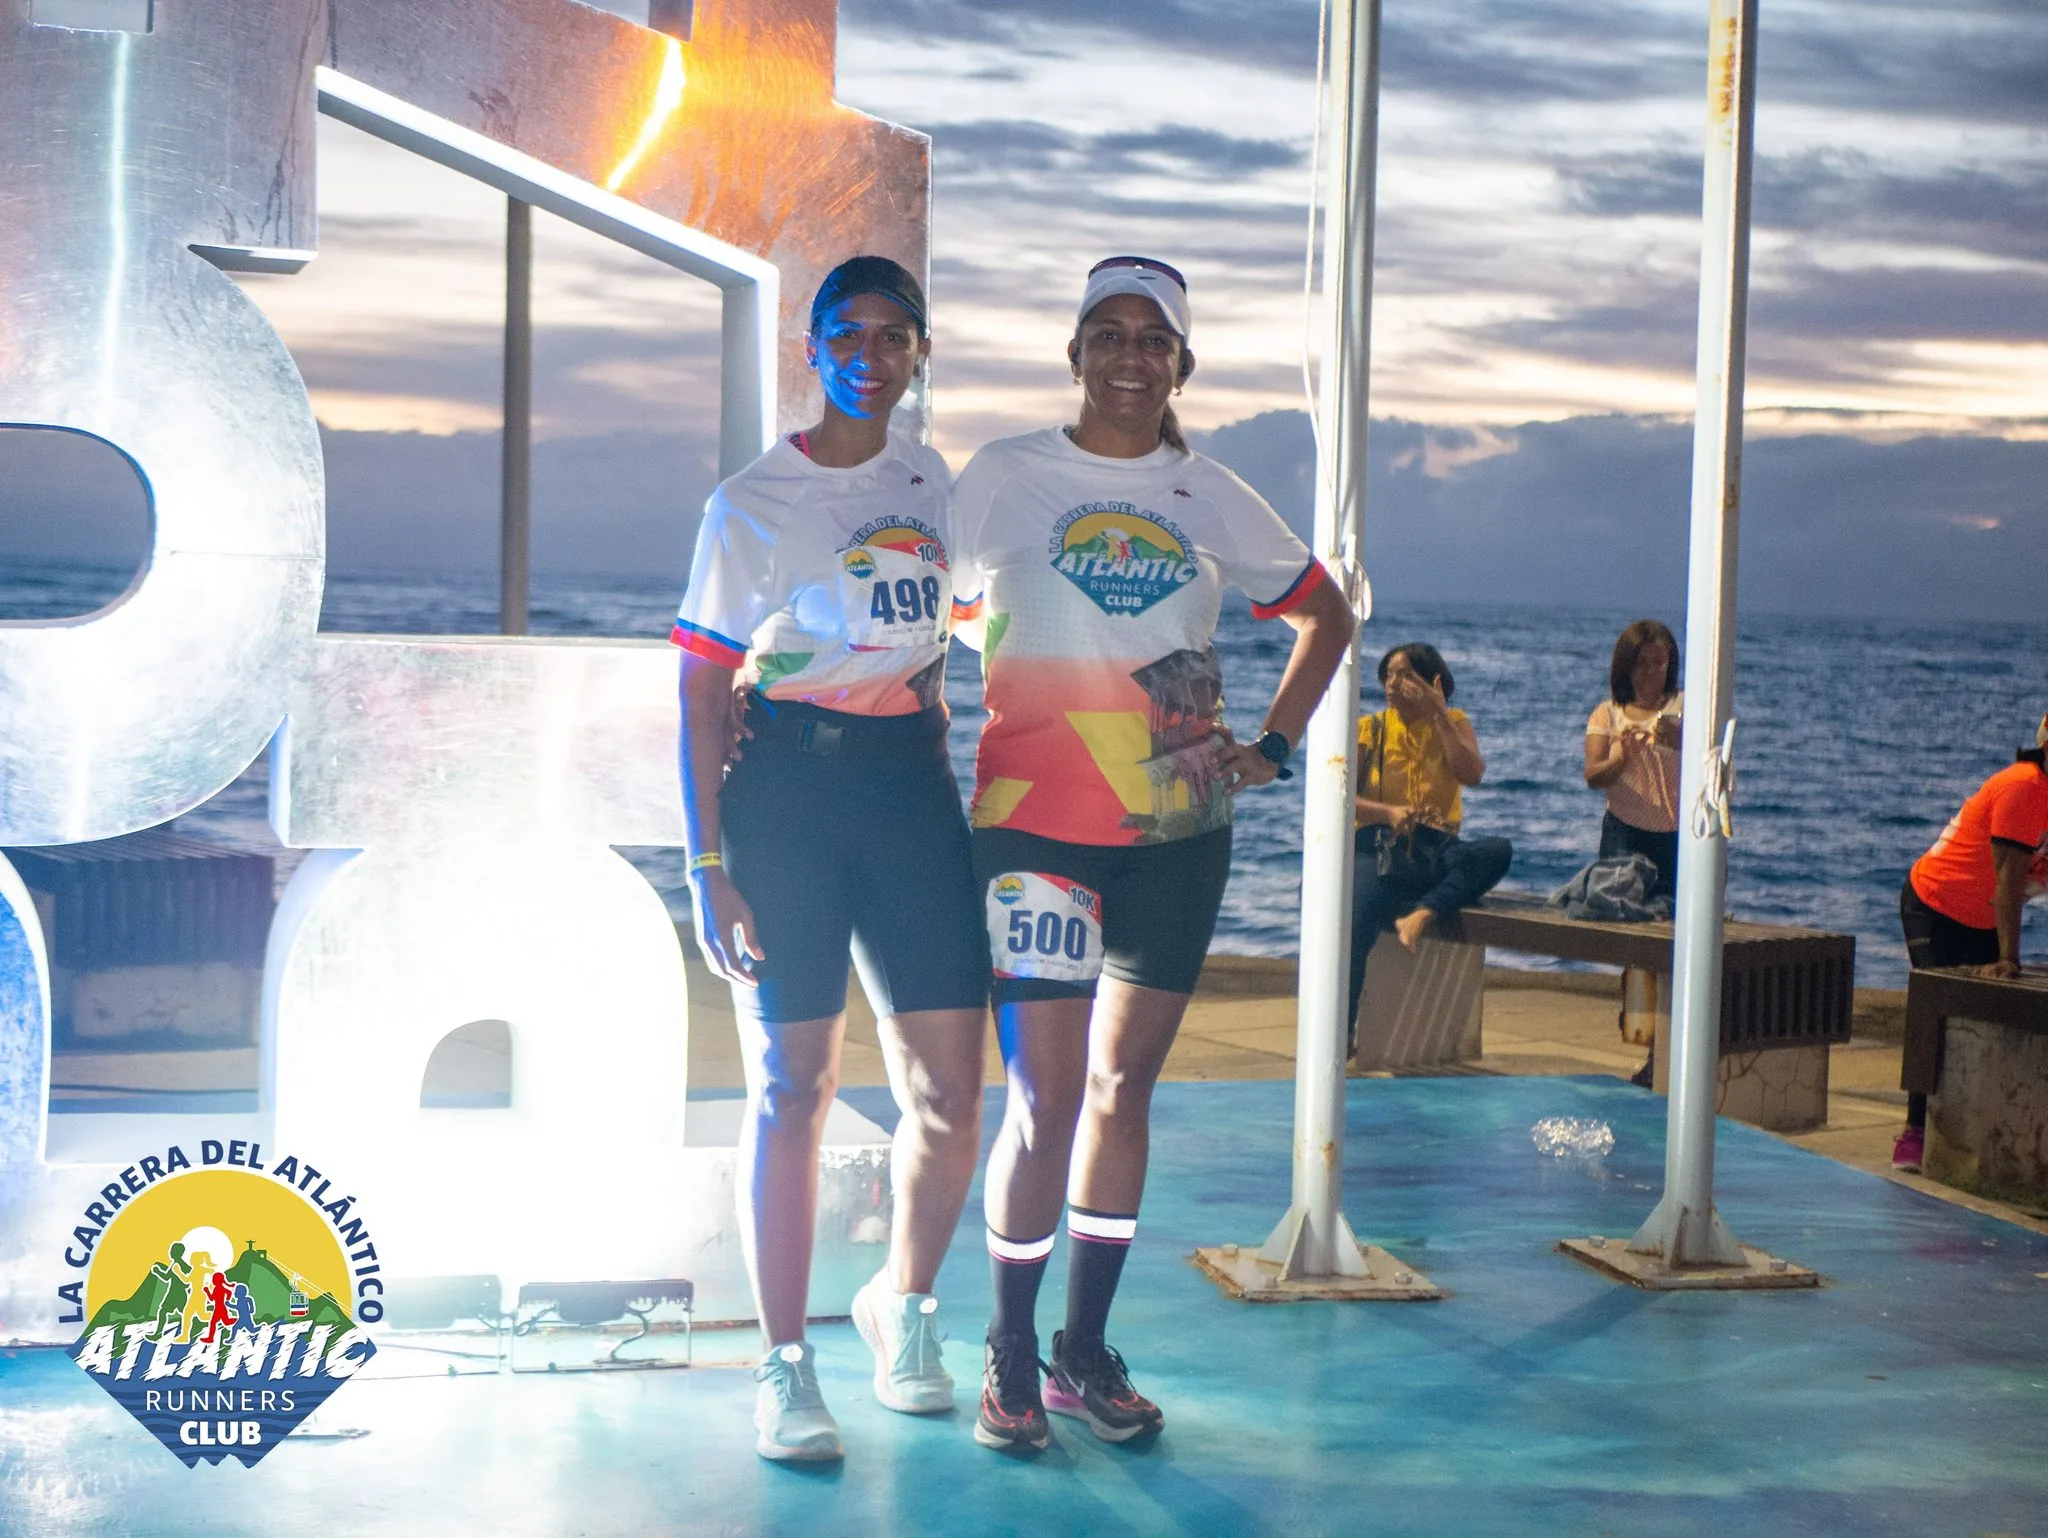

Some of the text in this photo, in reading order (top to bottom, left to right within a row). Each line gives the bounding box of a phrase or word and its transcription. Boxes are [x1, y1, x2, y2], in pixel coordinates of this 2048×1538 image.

[1053, 501, 1109, 535] CARRERA
[1108, 501, 1138, 516] DEL
[876, 516, 904, 529] DEL
[1049, 537, 1063, 553] LA
[1057, 552, 1194, 583] ATLANTIC
[1090, 581, 1160, 595] RUNNERS
[871, 575, 939, 625] 498
[1105, 595, 1142, 608] CLUB
[1070, 887, 1096, 912] 10K
[1007, 910, 1087, 961] 500
